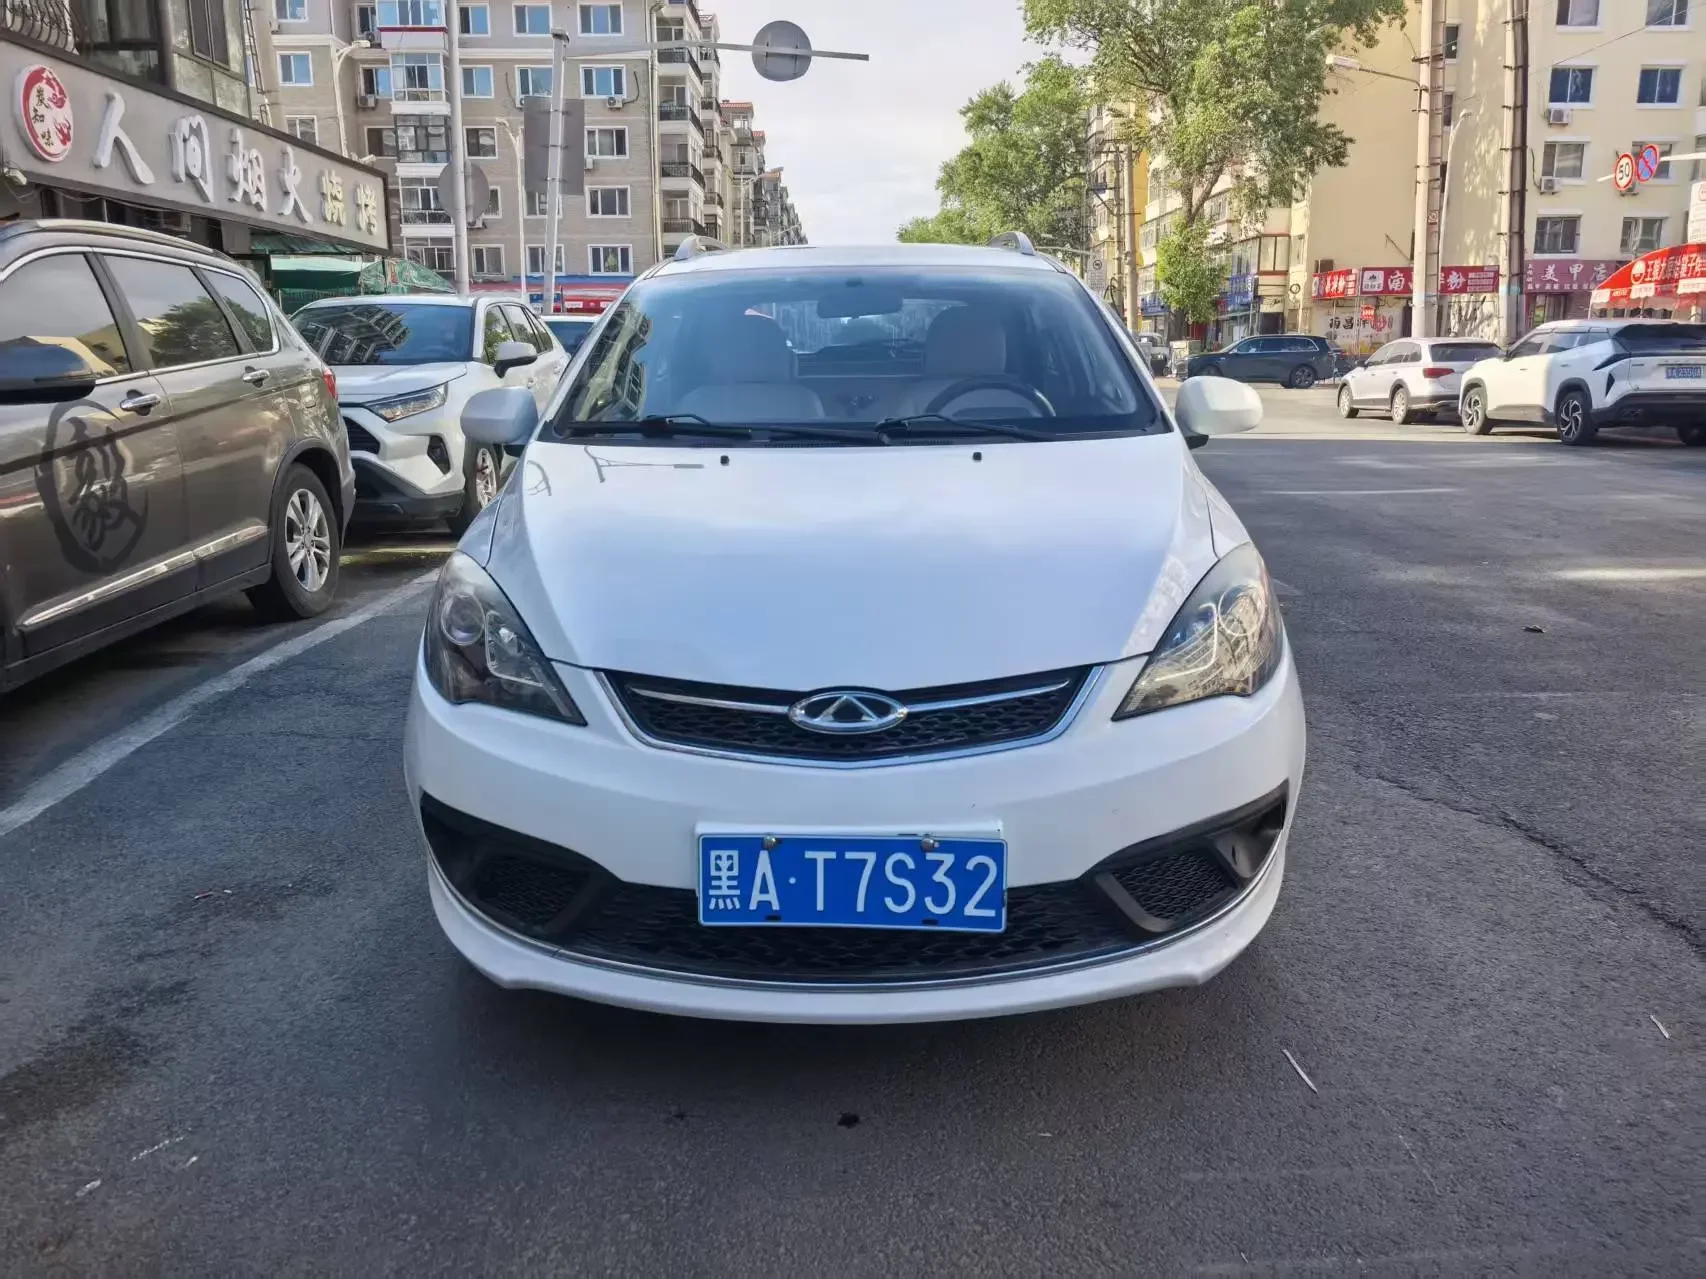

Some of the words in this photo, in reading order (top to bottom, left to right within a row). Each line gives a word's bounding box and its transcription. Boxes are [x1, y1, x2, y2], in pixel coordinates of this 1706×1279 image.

[1618, 162, 1630, 181] 50
[1541, 263, 1607, 282] 美甲店
[709, 850, 998, 917] 黑A·T7S32
